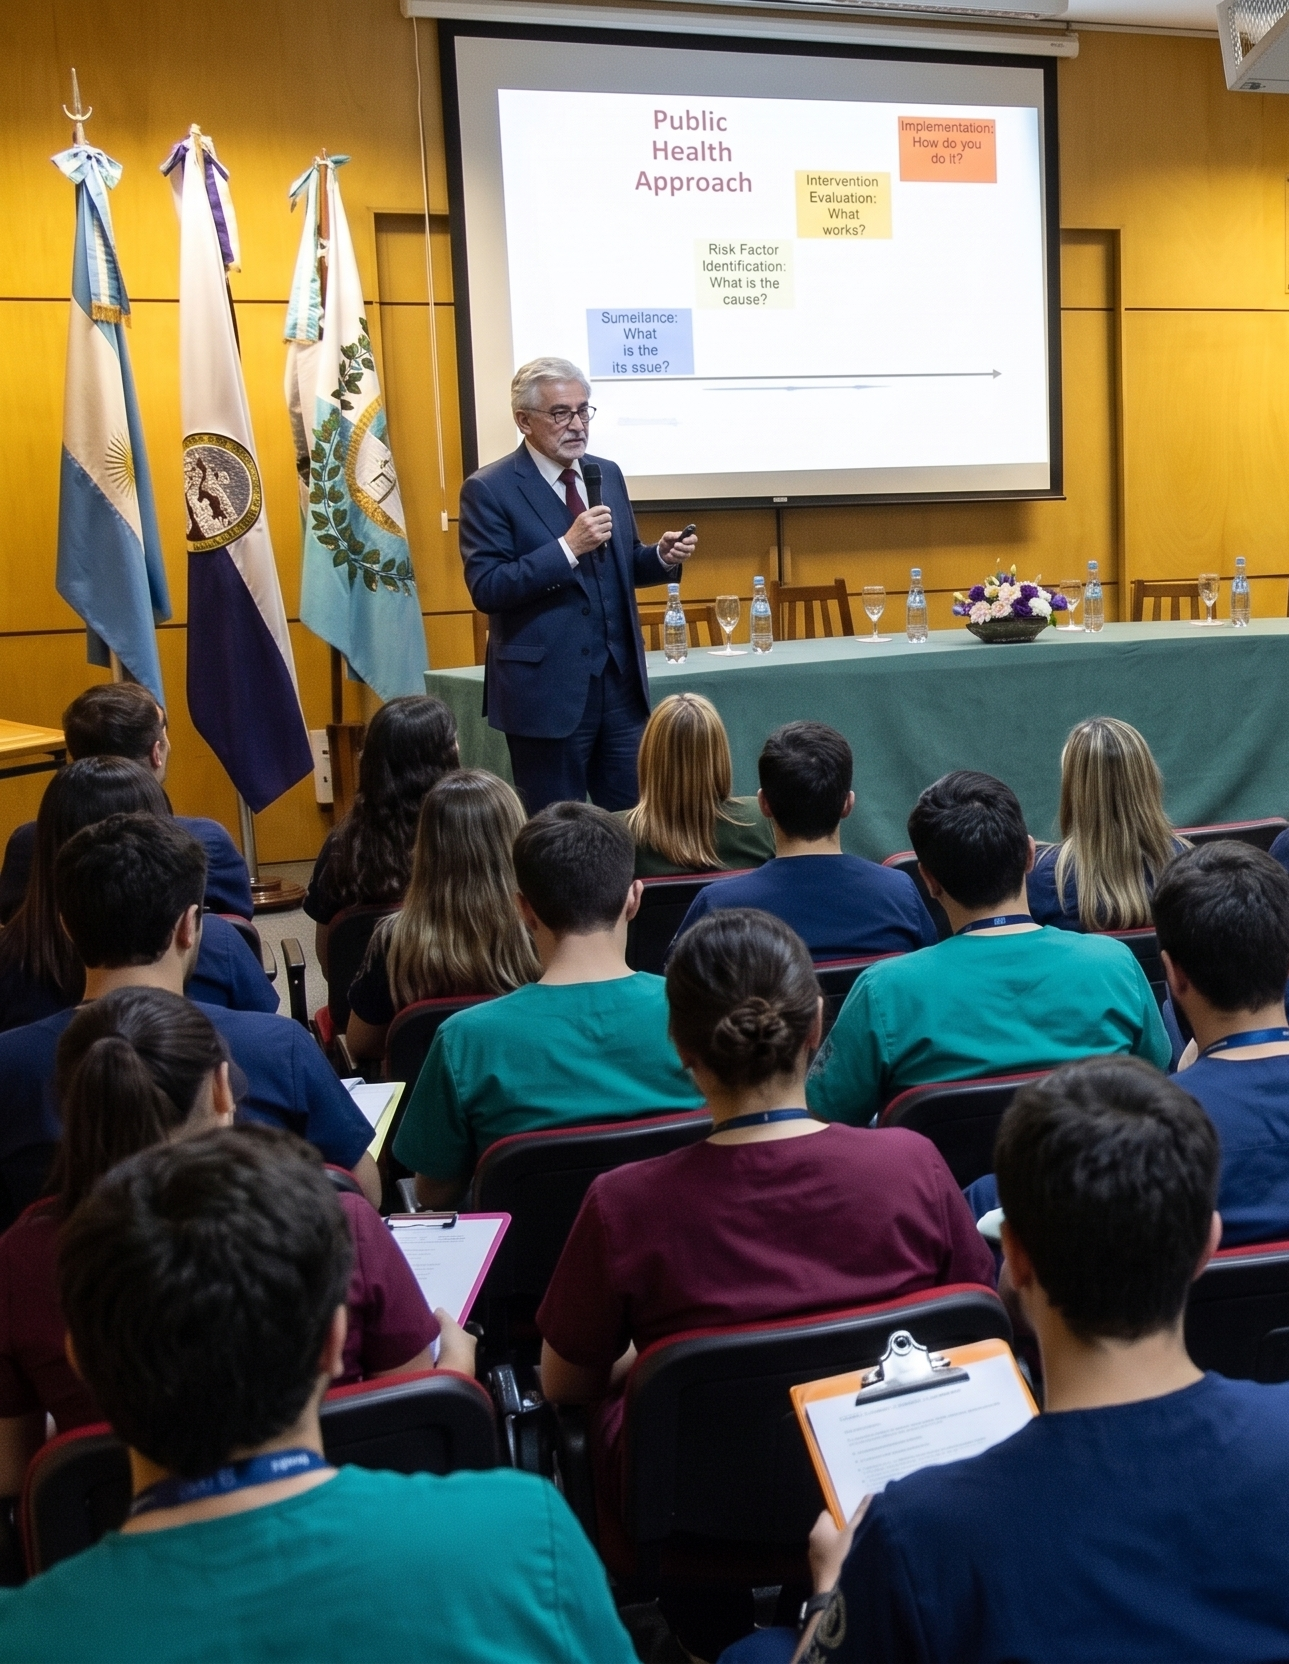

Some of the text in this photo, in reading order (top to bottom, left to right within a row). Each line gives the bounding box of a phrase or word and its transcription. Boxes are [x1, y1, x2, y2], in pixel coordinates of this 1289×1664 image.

[653, 109, 728, 132] Public
[901, 120, 994, 134] Implementation:
[913, 137, 981, 151] How do you
[652, 140, 732, 162] Health
[931, 153, 945, 164] do
[635, 170, 752, 197] Approach
[806, 174, 879, 187] Intervention
[809, 191, 877, 204] Evaluation:
[828, 208, 860, 220] What
[823, 224, 866, 236] works?
[709, 243, 779, 255] Risk Factor
[702, 260, 786, 272] Identification:
[710, 277, 780, 289] What is the
[723, 293, 767, 305] cause?
[623, 328, 657, 340] What
[623, 345, 658, 356] is the
[612, 361, 670, 373] its ssue?
